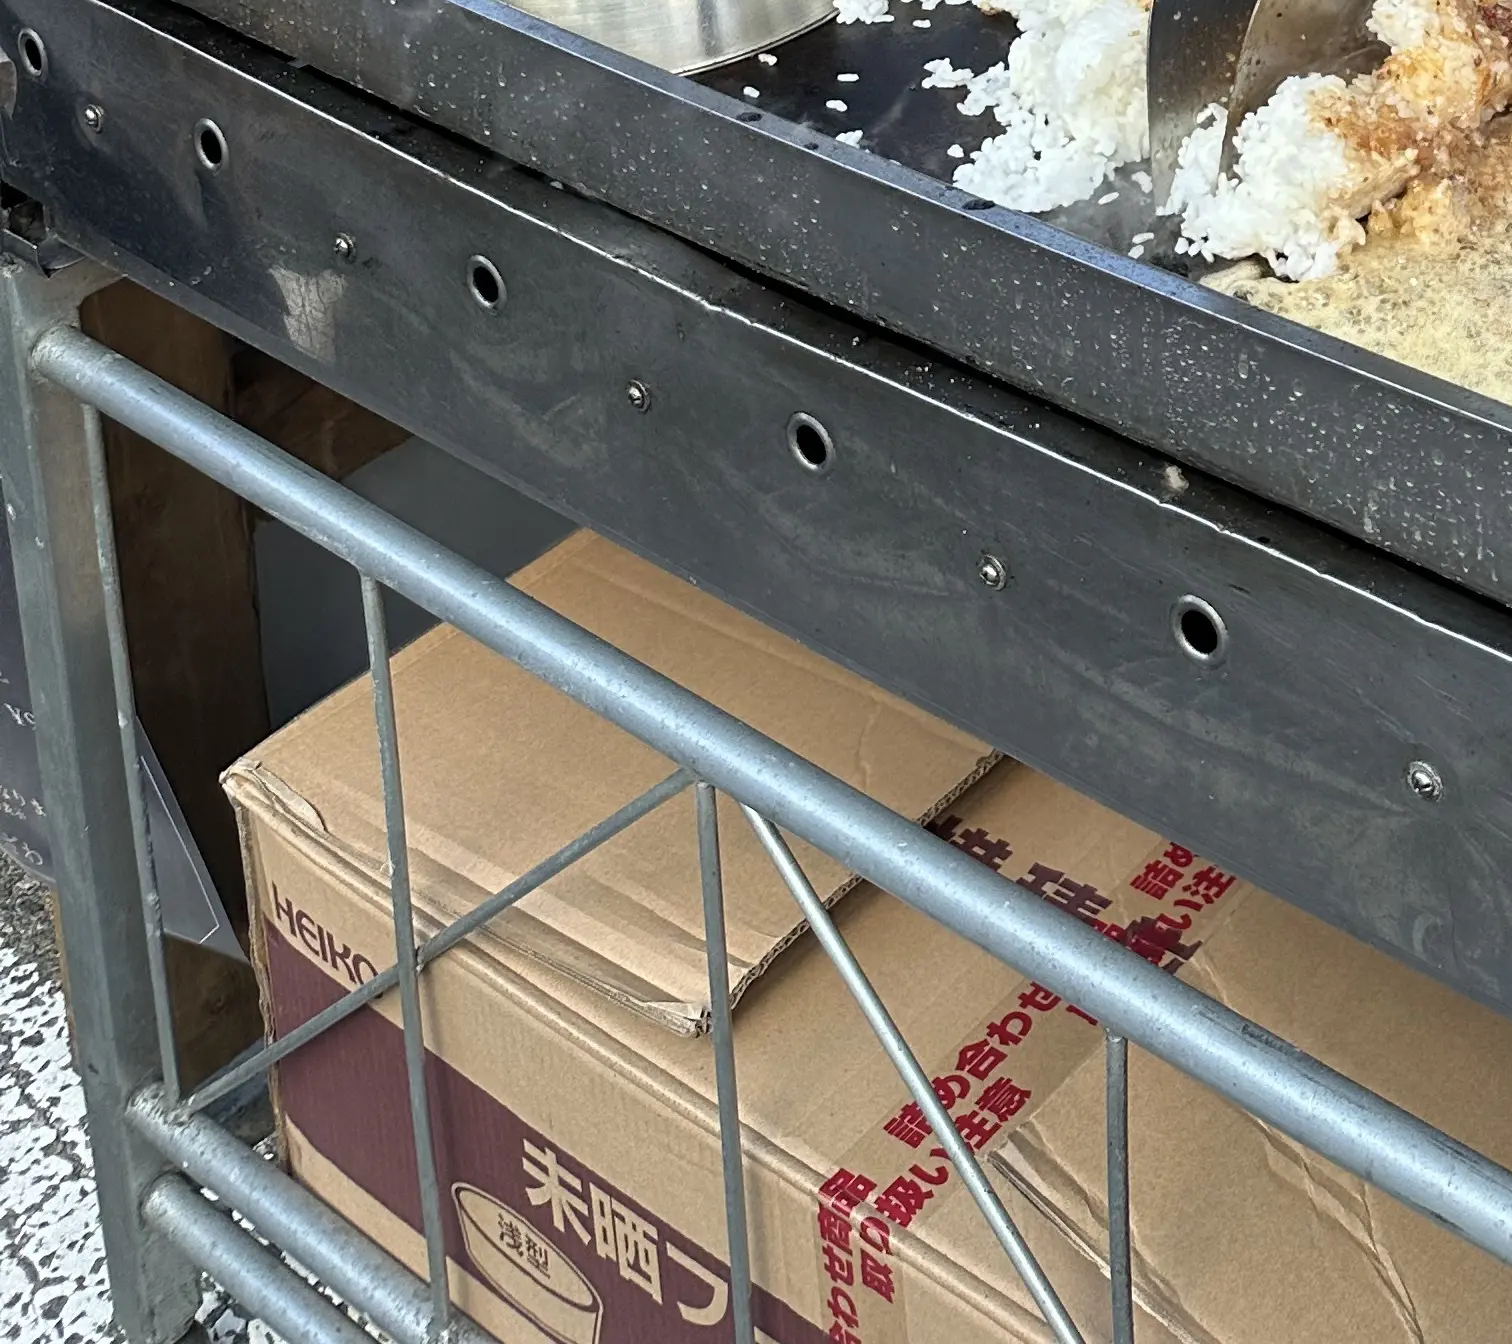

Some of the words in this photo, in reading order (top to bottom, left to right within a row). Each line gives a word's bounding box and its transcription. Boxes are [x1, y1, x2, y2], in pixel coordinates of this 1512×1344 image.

[272, 879, 384, 1000] HEIKO
[498, 1212, 551, 1279] 浅型
[521, 1138, 780, 1344] 未晒フ
